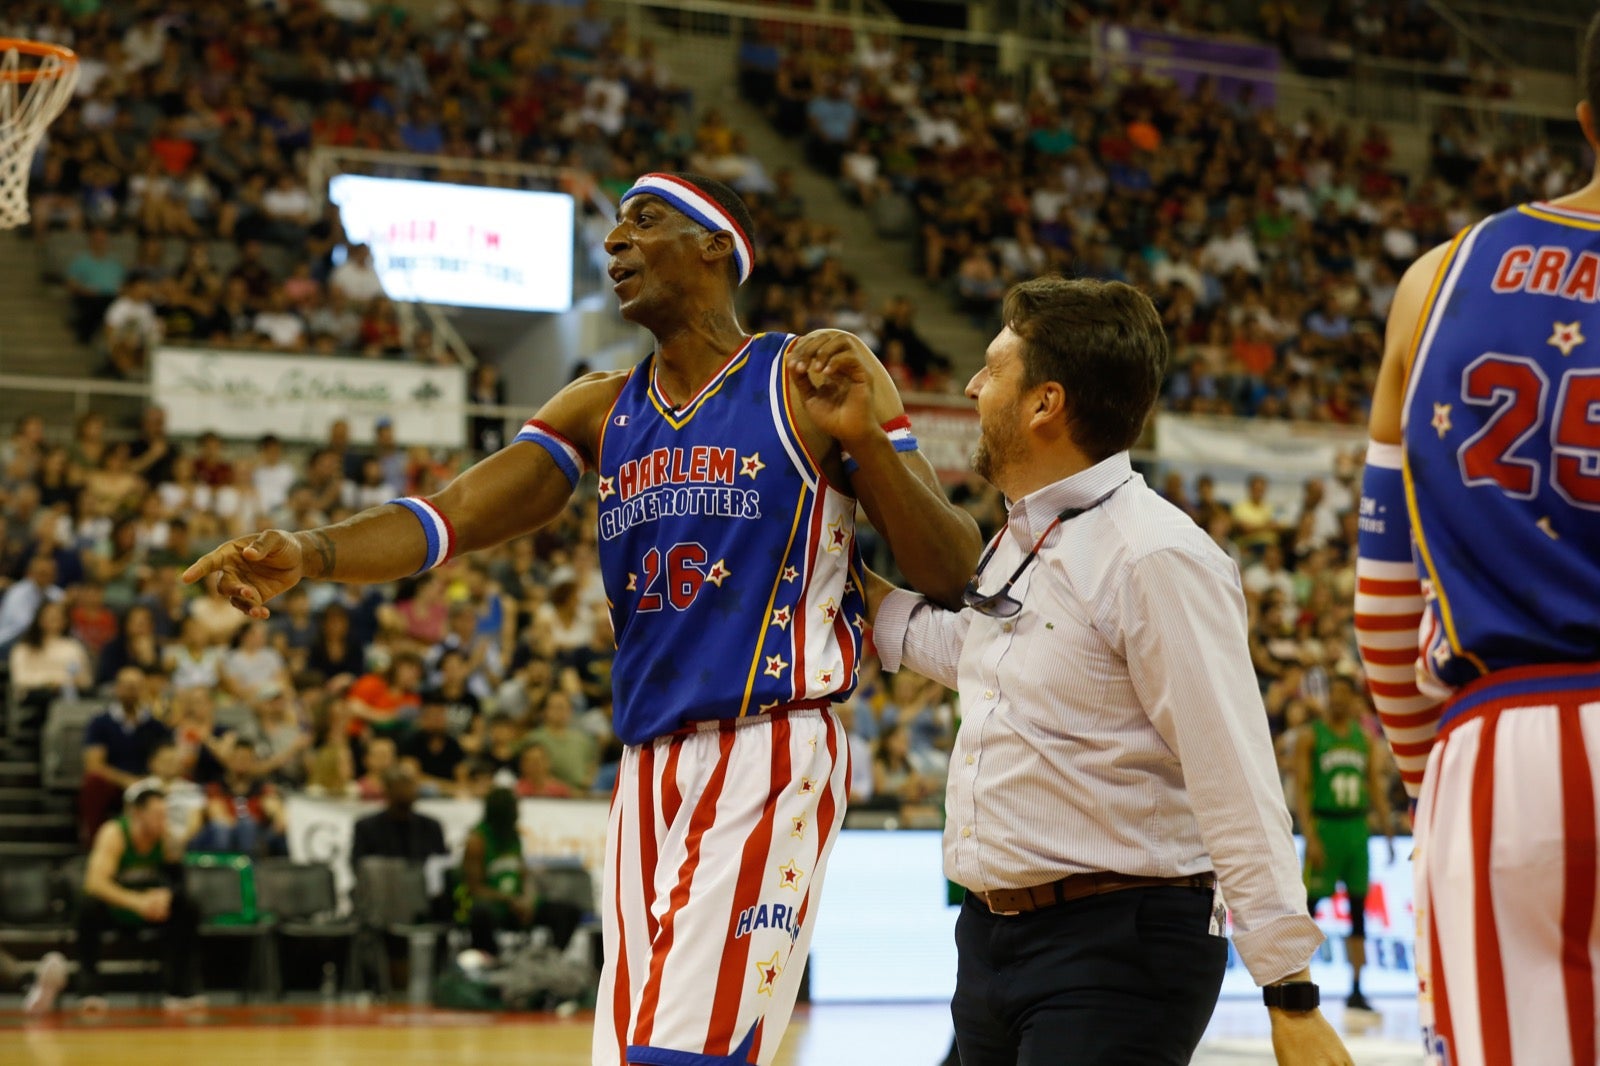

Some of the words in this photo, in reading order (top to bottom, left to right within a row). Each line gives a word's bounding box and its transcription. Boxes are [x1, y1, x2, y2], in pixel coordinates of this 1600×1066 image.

[619, 446, 737, 501] HARLEM
[600, 487, 760, 540] GLOBETROTTERS
[635, 542, 707, 613] 26
